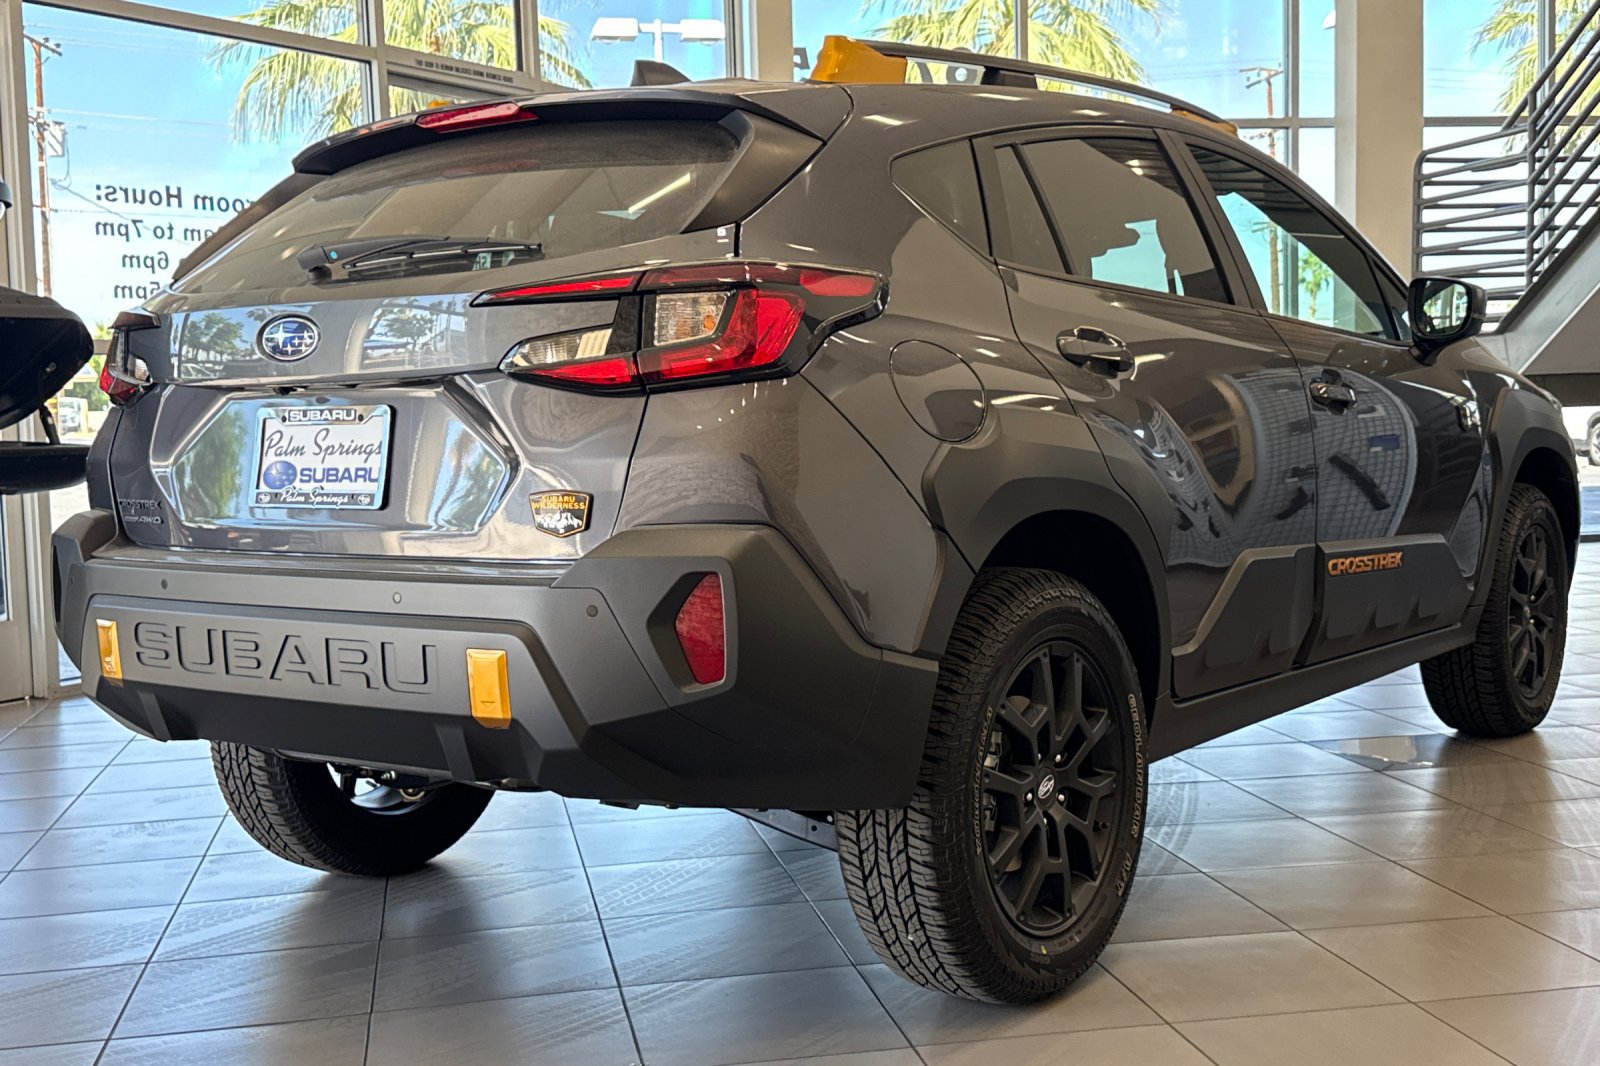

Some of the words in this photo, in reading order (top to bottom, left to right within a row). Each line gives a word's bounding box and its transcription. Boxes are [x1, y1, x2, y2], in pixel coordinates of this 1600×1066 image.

[289, 409, 355, 421] SUBARU
[265, 429, 306, 458] Palm
[312, 427, 383, 464] Springs
[299, 466, 380, 484] SUBARU
[280, 486, 306, 503] Palm
[308, 486, 349, 507] Springs
[531, 501, 586, 510] WILDERNESS
[541, 494, 576, 503] SUBARU
[1327, 551, 1404, 577] CROSSTREK
[133, 621, 440, 695] SUBARU
